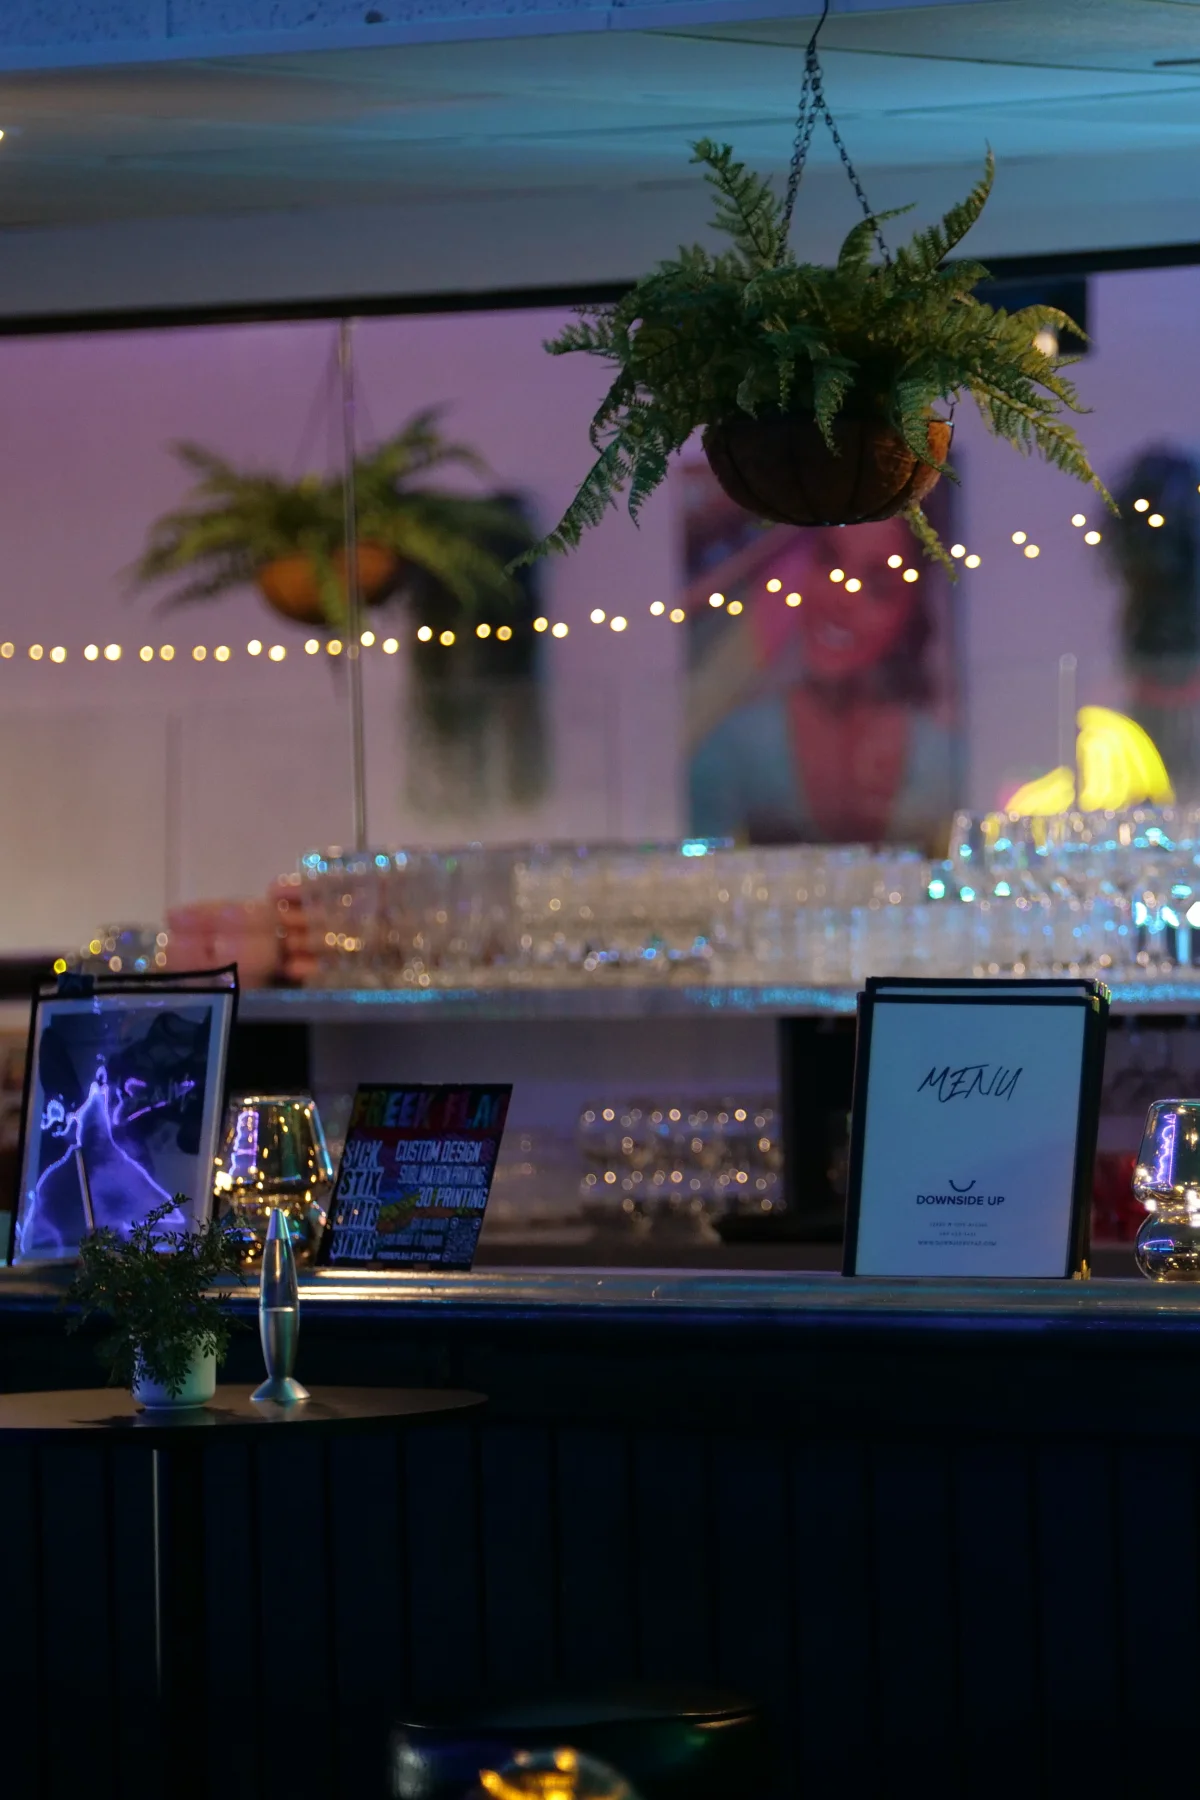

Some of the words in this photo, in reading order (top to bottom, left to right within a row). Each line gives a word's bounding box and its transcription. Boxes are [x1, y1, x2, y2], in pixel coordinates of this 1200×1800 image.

[917, 1064, 1023, 1103] MENU
[343, 1140, 383, 1168] SICK
[395, 1140, 441, 1162] CUSTOM
[440, 1141, 482, 1162] DESIGN
[341, 1170, 380, 1197] STIX
[415, 1186, 434, 1207] 3D
[434, 1187, 488, 1208] PRINTING
[916, 1195, 984, 1206] DOWNSIDE
[988, 1196, 1005, 1206] UP
